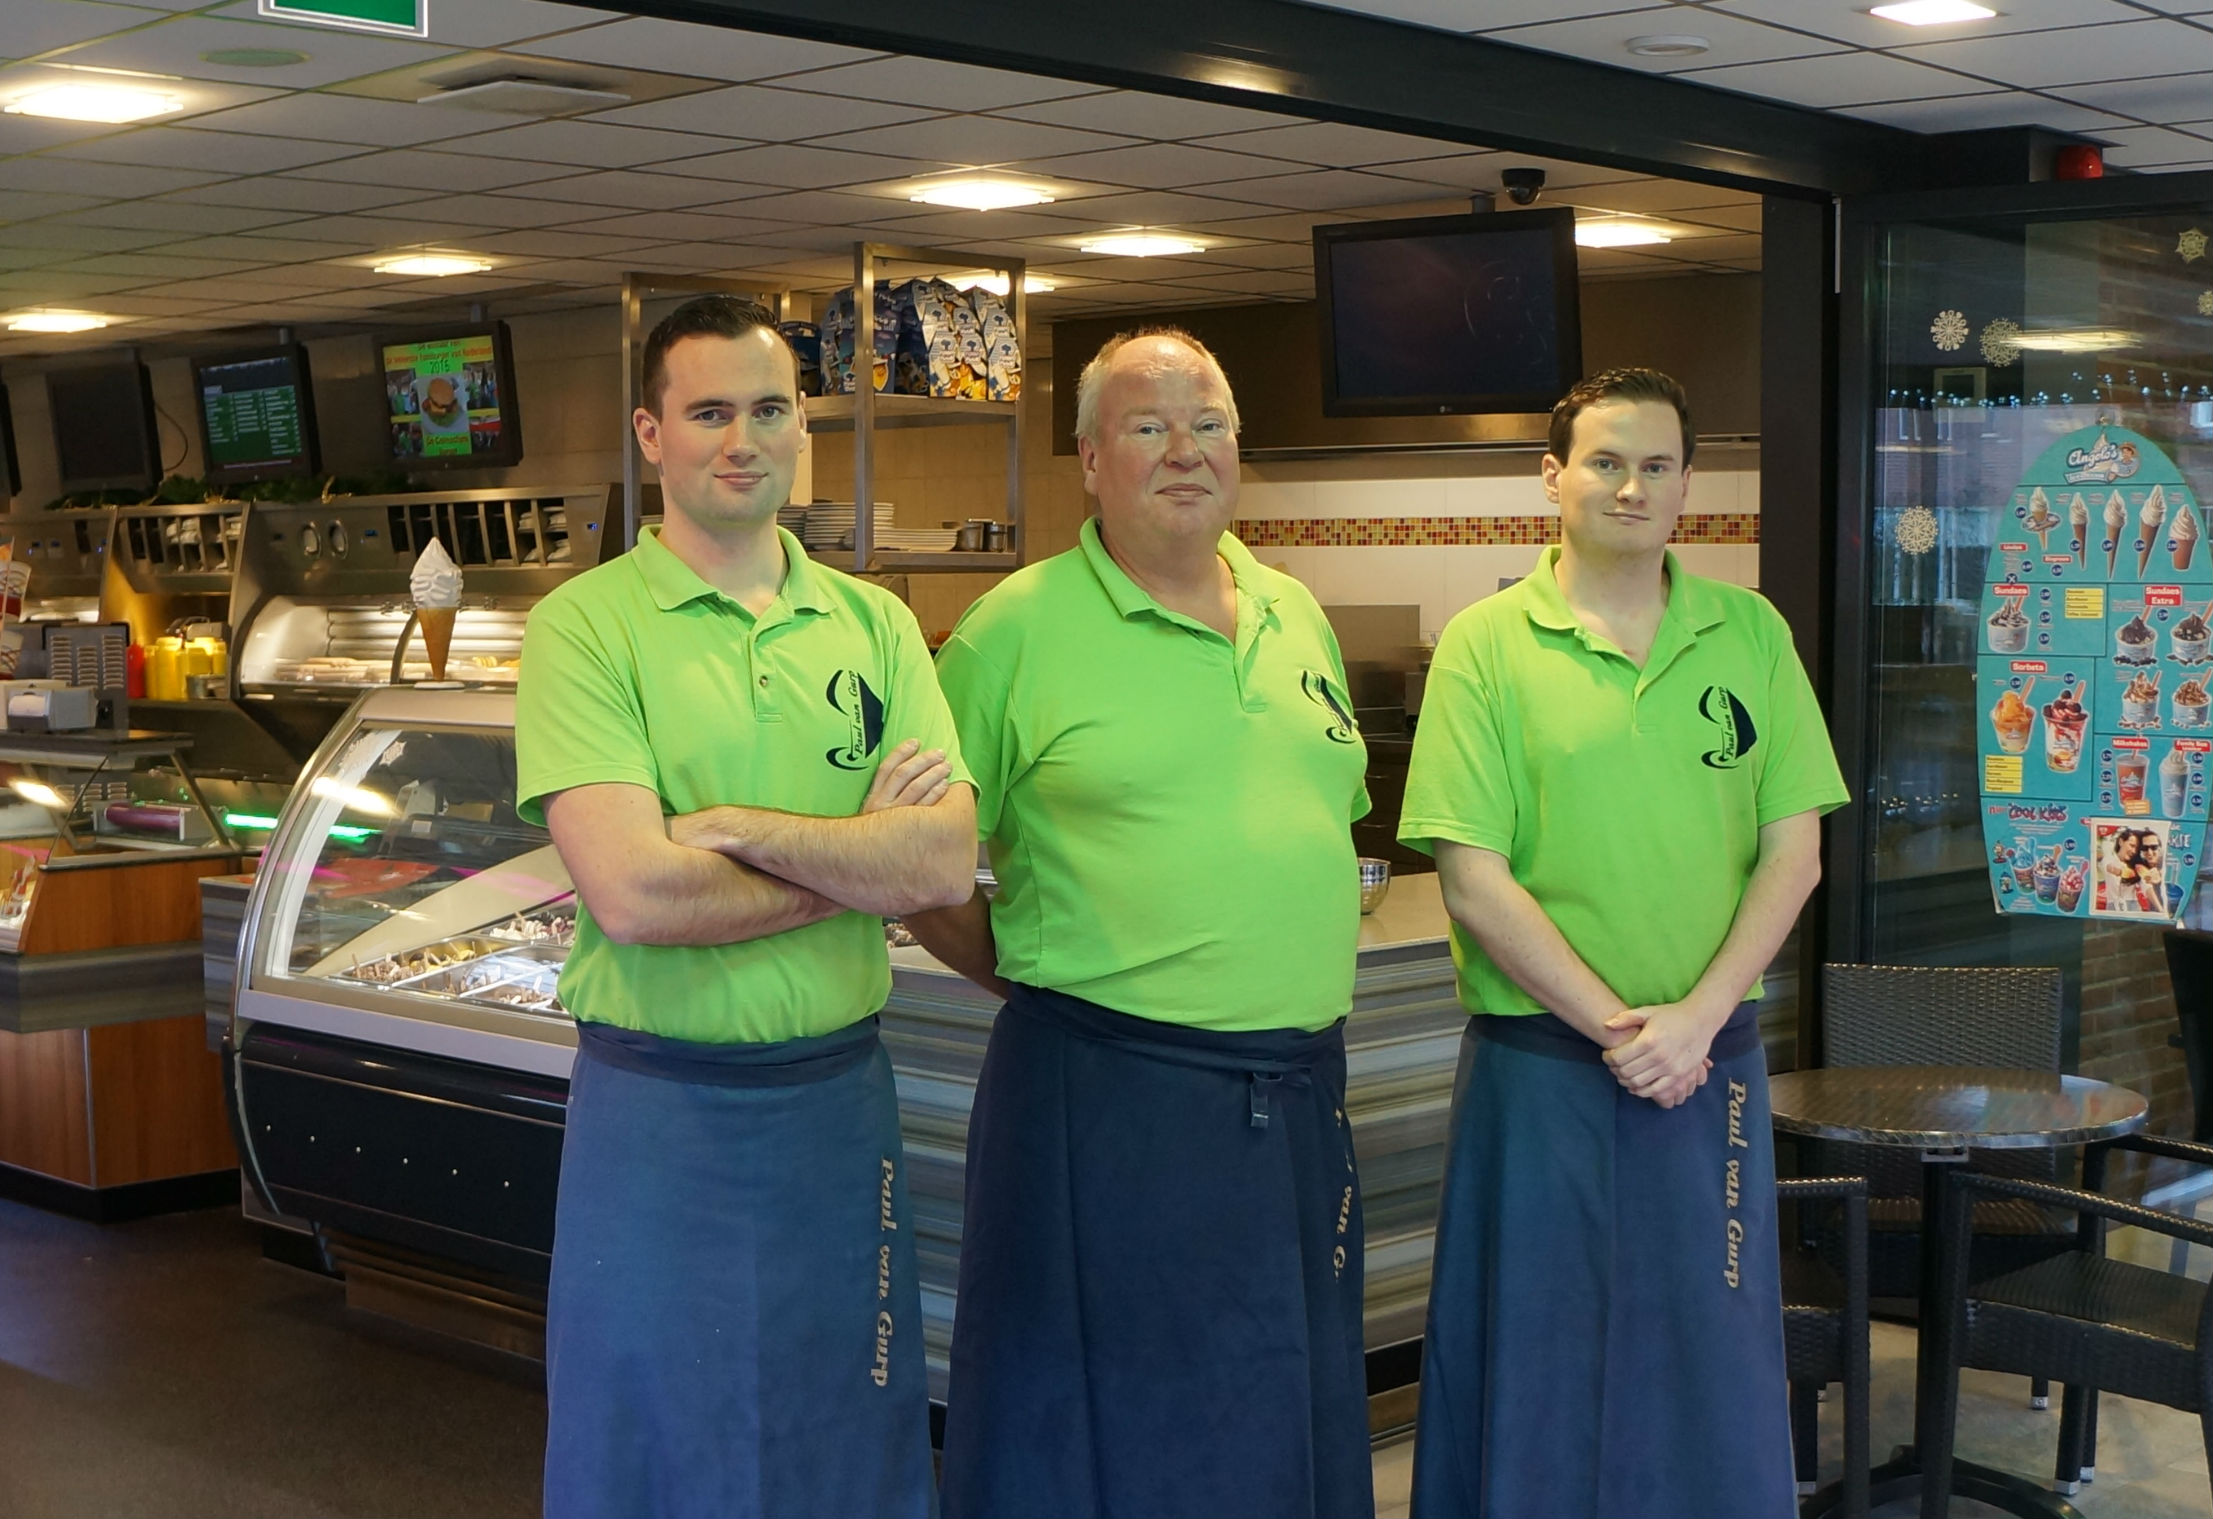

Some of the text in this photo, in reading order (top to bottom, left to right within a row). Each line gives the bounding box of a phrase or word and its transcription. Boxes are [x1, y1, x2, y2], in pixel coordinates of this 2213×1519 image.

[1994, 586, 2027, 595] Sundaes
[2146, 587, 2180, 595] Sundaes
[2151, 597, 2174, 605] Extra
[848, 670, 862, 755] Paul van Gurp
[1718, 686, 1734, 756] Paul van Gurp
[1336, 1185, 1352, 1235] van
[1723, 1078, 1748, 1289] Paul van Gurp
[871, 1158, 898, 1387] Paul van Gurp
